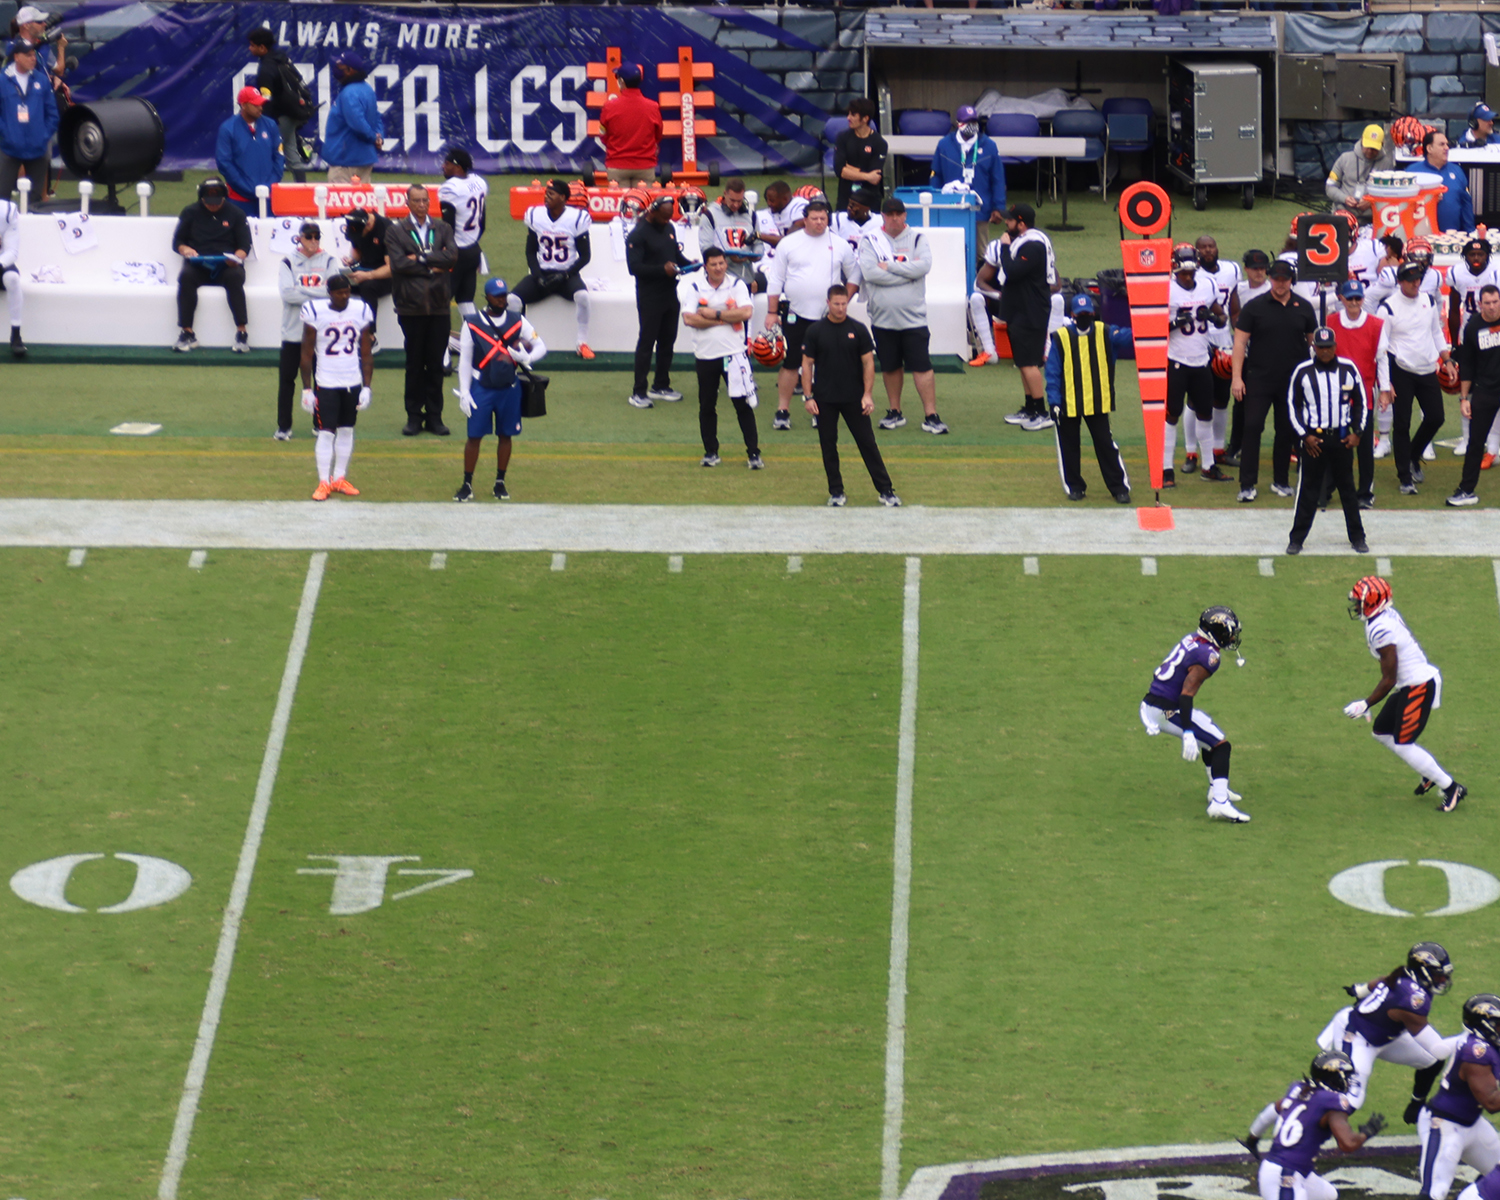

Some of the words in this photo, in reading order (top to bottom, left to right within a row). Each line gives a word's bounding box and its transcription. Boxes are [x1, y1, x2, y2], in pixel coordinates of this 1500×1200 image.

[397, 23, 491, 49] MORE.
[475, 64, 606, 153] LES
[681, 93, 696, 162] GATORADE
[539, 236, 569, 263] 35
[1306, 223, 1340, 266] 3
[324, 325, 357, 356] 23
[1273, 1104, 1307, 1148] 6
